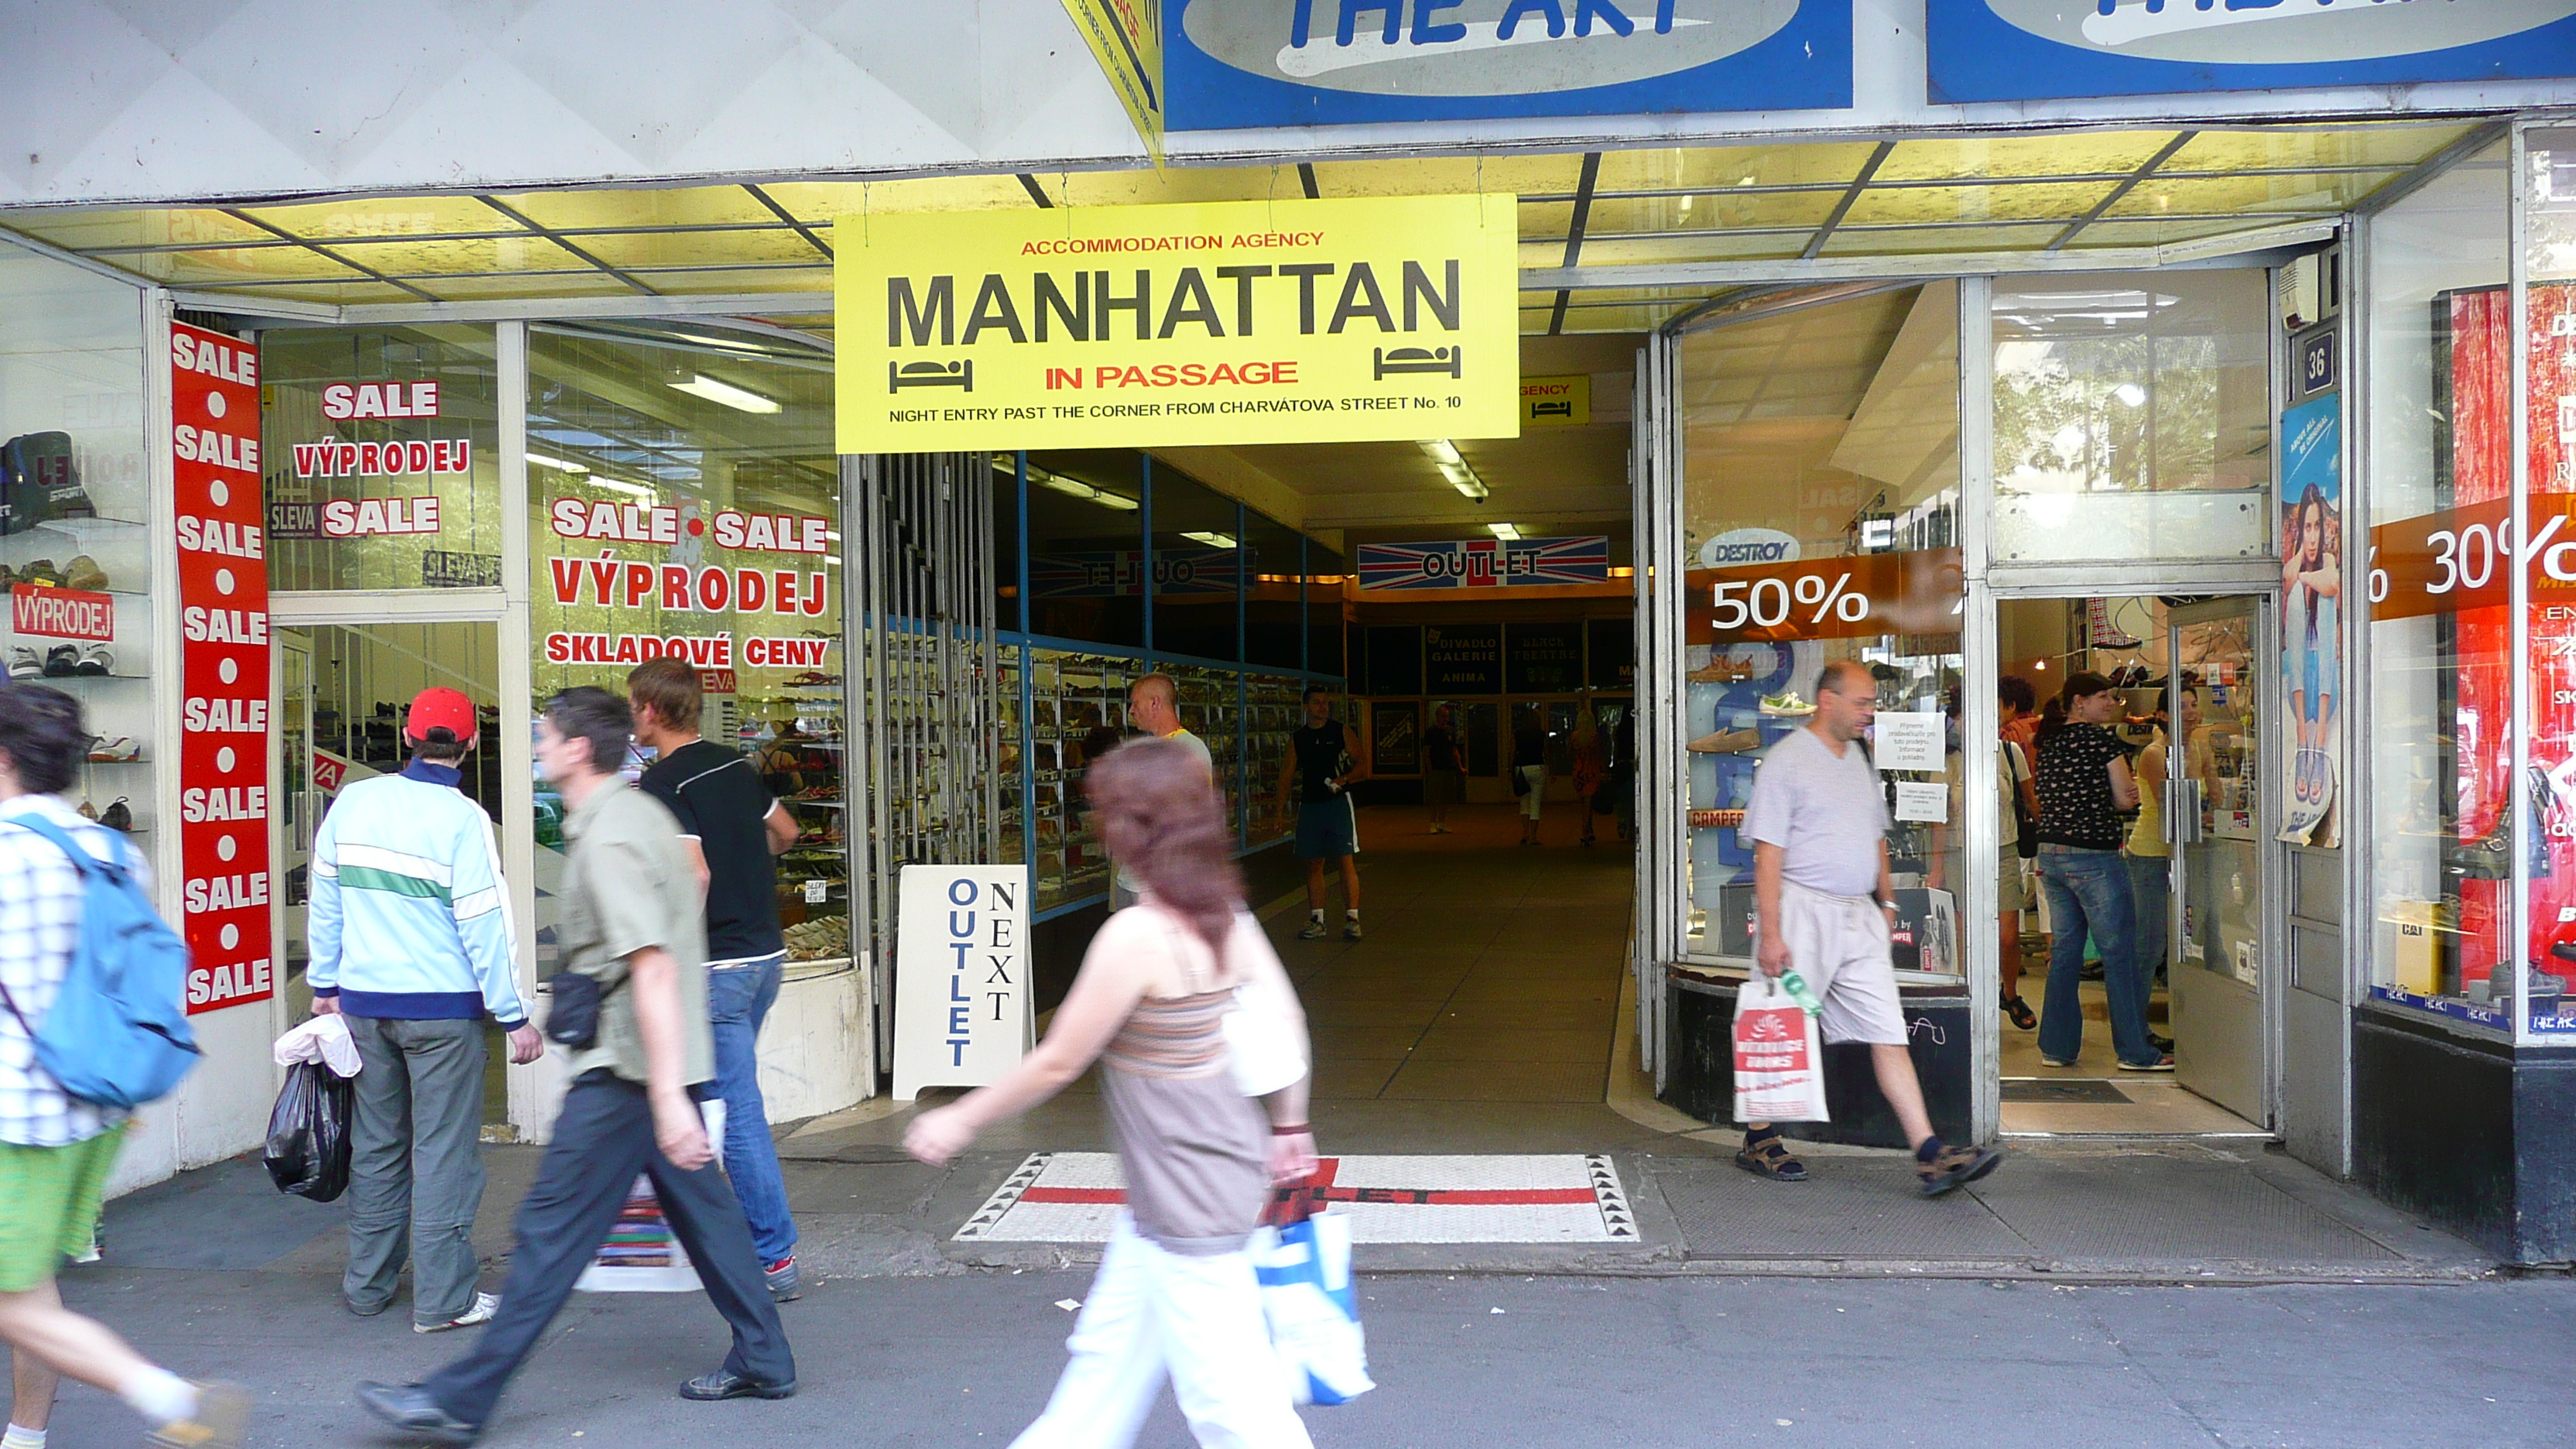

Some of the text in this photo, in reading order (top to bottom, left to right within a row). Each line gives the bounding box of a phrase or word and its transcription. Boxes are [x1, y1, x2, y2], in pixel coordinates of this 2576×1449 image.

[1021, 231, 1325, 256] ACCOMMODATION AGENCY
[887, 259, 1461, 348] MANHATTAN
[173, 334, 256, 386] SALE
[1046, 361, 1299, 391] IN PASSAGE
[2309, 348, 2324, 380] 36
[322, 381, 439, 420] SALE
[1519, 384, 1570, 396] GENCY
[889, 396, 1461, 423] NIGHT ENTRY PAST THE CORNER FROM CHARVÁTOVA STREET No. 10
[175, 424, 259, 473] SALE
[293, 436, 471, 478] VÝPRODEJ
[272, 505, 316, 530] SLEVA
[322, 497, 440, 538] SALE
[552, 498, 828, 553] SALE SALE
[178, 516, 262, 560] SALE
[1715, 542, 1790, 562] DESTROY
[1423, 549, 1542, 578] OUTLET
[548, 548, 828, 618] VÝPRODEJ
[1711, 573, 1869, 629] 50%
[17, 588, 111, 637] VÝPRODEJ
[184, 606, 269, 646] SALE
[545, 631, 733, 669] SKLADOVÉ
[744, 636, 831, 667] CENY
[1432, 651, 1496, 663] GALERIE
[1440, 638, 1496, 649] DIVADLO
[703, 673, 735, 690] EVA
[1443, 672, 1485, 683] ANIMA
[184, 697, 267, 732] SALE
[183, 786, 266, 823] SALE
[186, 872, 268, 913] SALE
[985, 882, 1017, 1021] NEXT
[1891, 933, 1912, 943] MPER
[188, 958, 270, 1005] SALE
[946, 879, 979, 1067] OUTLET
[1277, 1186, 1447, 1204] TLET
